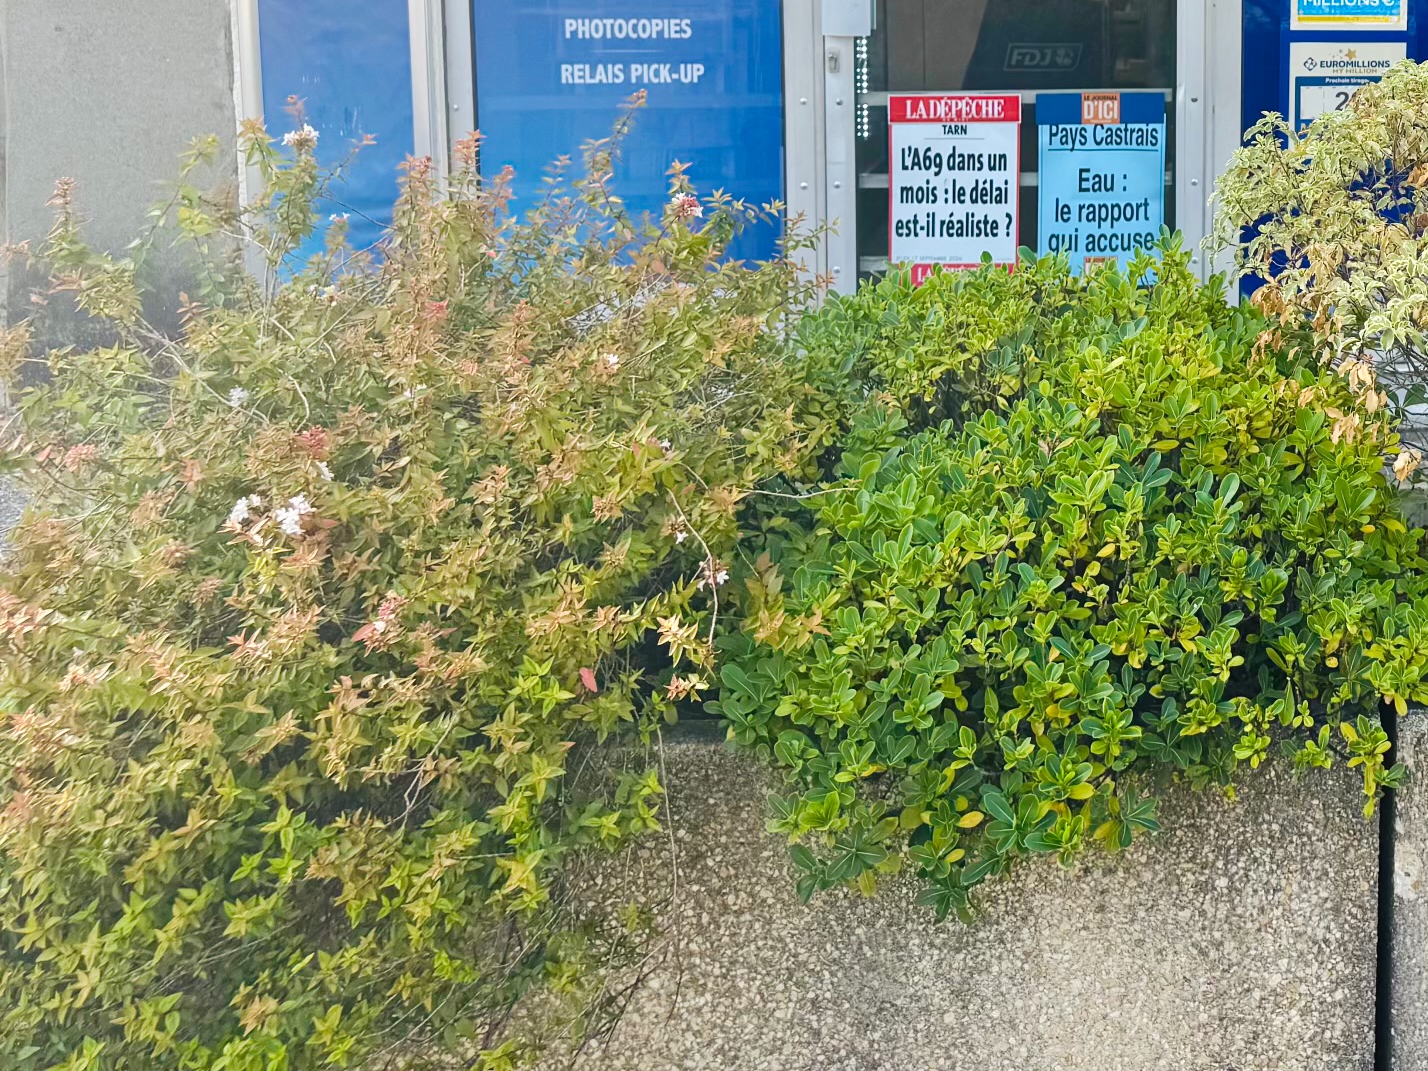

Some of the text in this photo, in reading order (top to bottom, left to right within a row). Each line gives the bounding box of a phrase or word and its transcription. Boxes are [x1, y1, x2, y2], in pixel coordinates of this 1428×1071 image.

[564, 19, 692, 39] PHOTOCOPIES
[1010, 49, 1052, 66] FDJ
[1320, 60, 1391, 68] EUROMILLIONS
[561, 64, 705, 84] RELAIS PICK-UP
[906, 96, 1005, 119] LA DÉPÊCHE
[1083, 100, 1118, 119] D'ICI
[942, 124, 967, 135] TARN
[1049, 123, 1159, 152] Pays Castrais
[901, 145, 1007, 177] L'A69 dans un
[900, 178, 1009, 204] mois : le délai
[1078, 168, 1127, 193] Eau :
[895, 211, 1013, 237] est-il réaliste ?
[1055, 197, 1150, 229] le rapport
[1048, 227, 1155, 255] qui accuse
